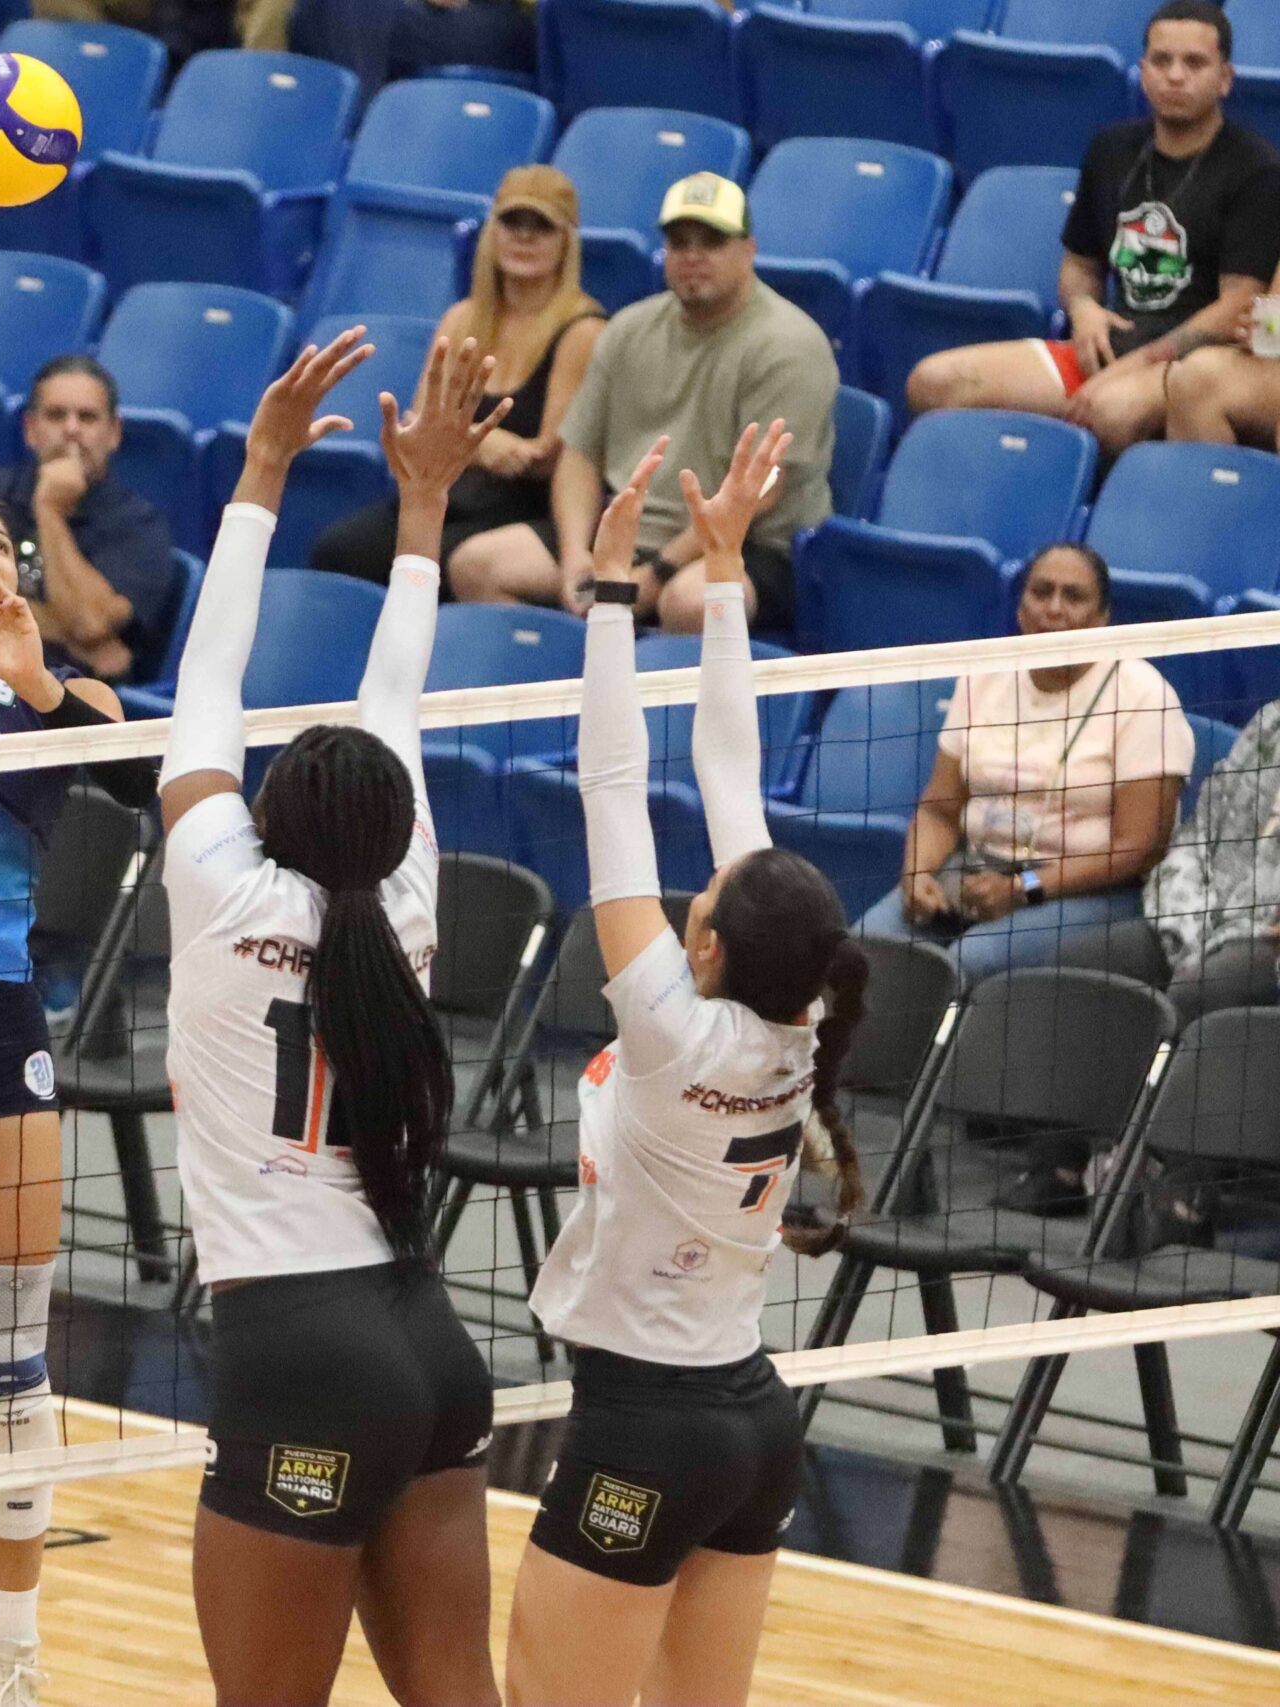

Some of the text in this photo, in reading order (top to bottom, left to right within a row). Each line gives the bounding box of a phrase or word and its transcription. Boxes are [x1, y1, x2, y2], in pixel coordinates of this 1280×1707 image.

[722, 1119, 803, 1215] 7
[284, 1449, 336, 1462] PUERTO RICO
[279, 1460, 337, 1479] ARMY
[277, 1472, 334, 1489] NATIONAL
[602, 1481, 647, 1500] PUERTO RICO
[591, 1502, 642, 1526] NATIONAL
[595, 1491, 647, 1516] ARMY
[588, 1511, 640, 1537] GUARD
